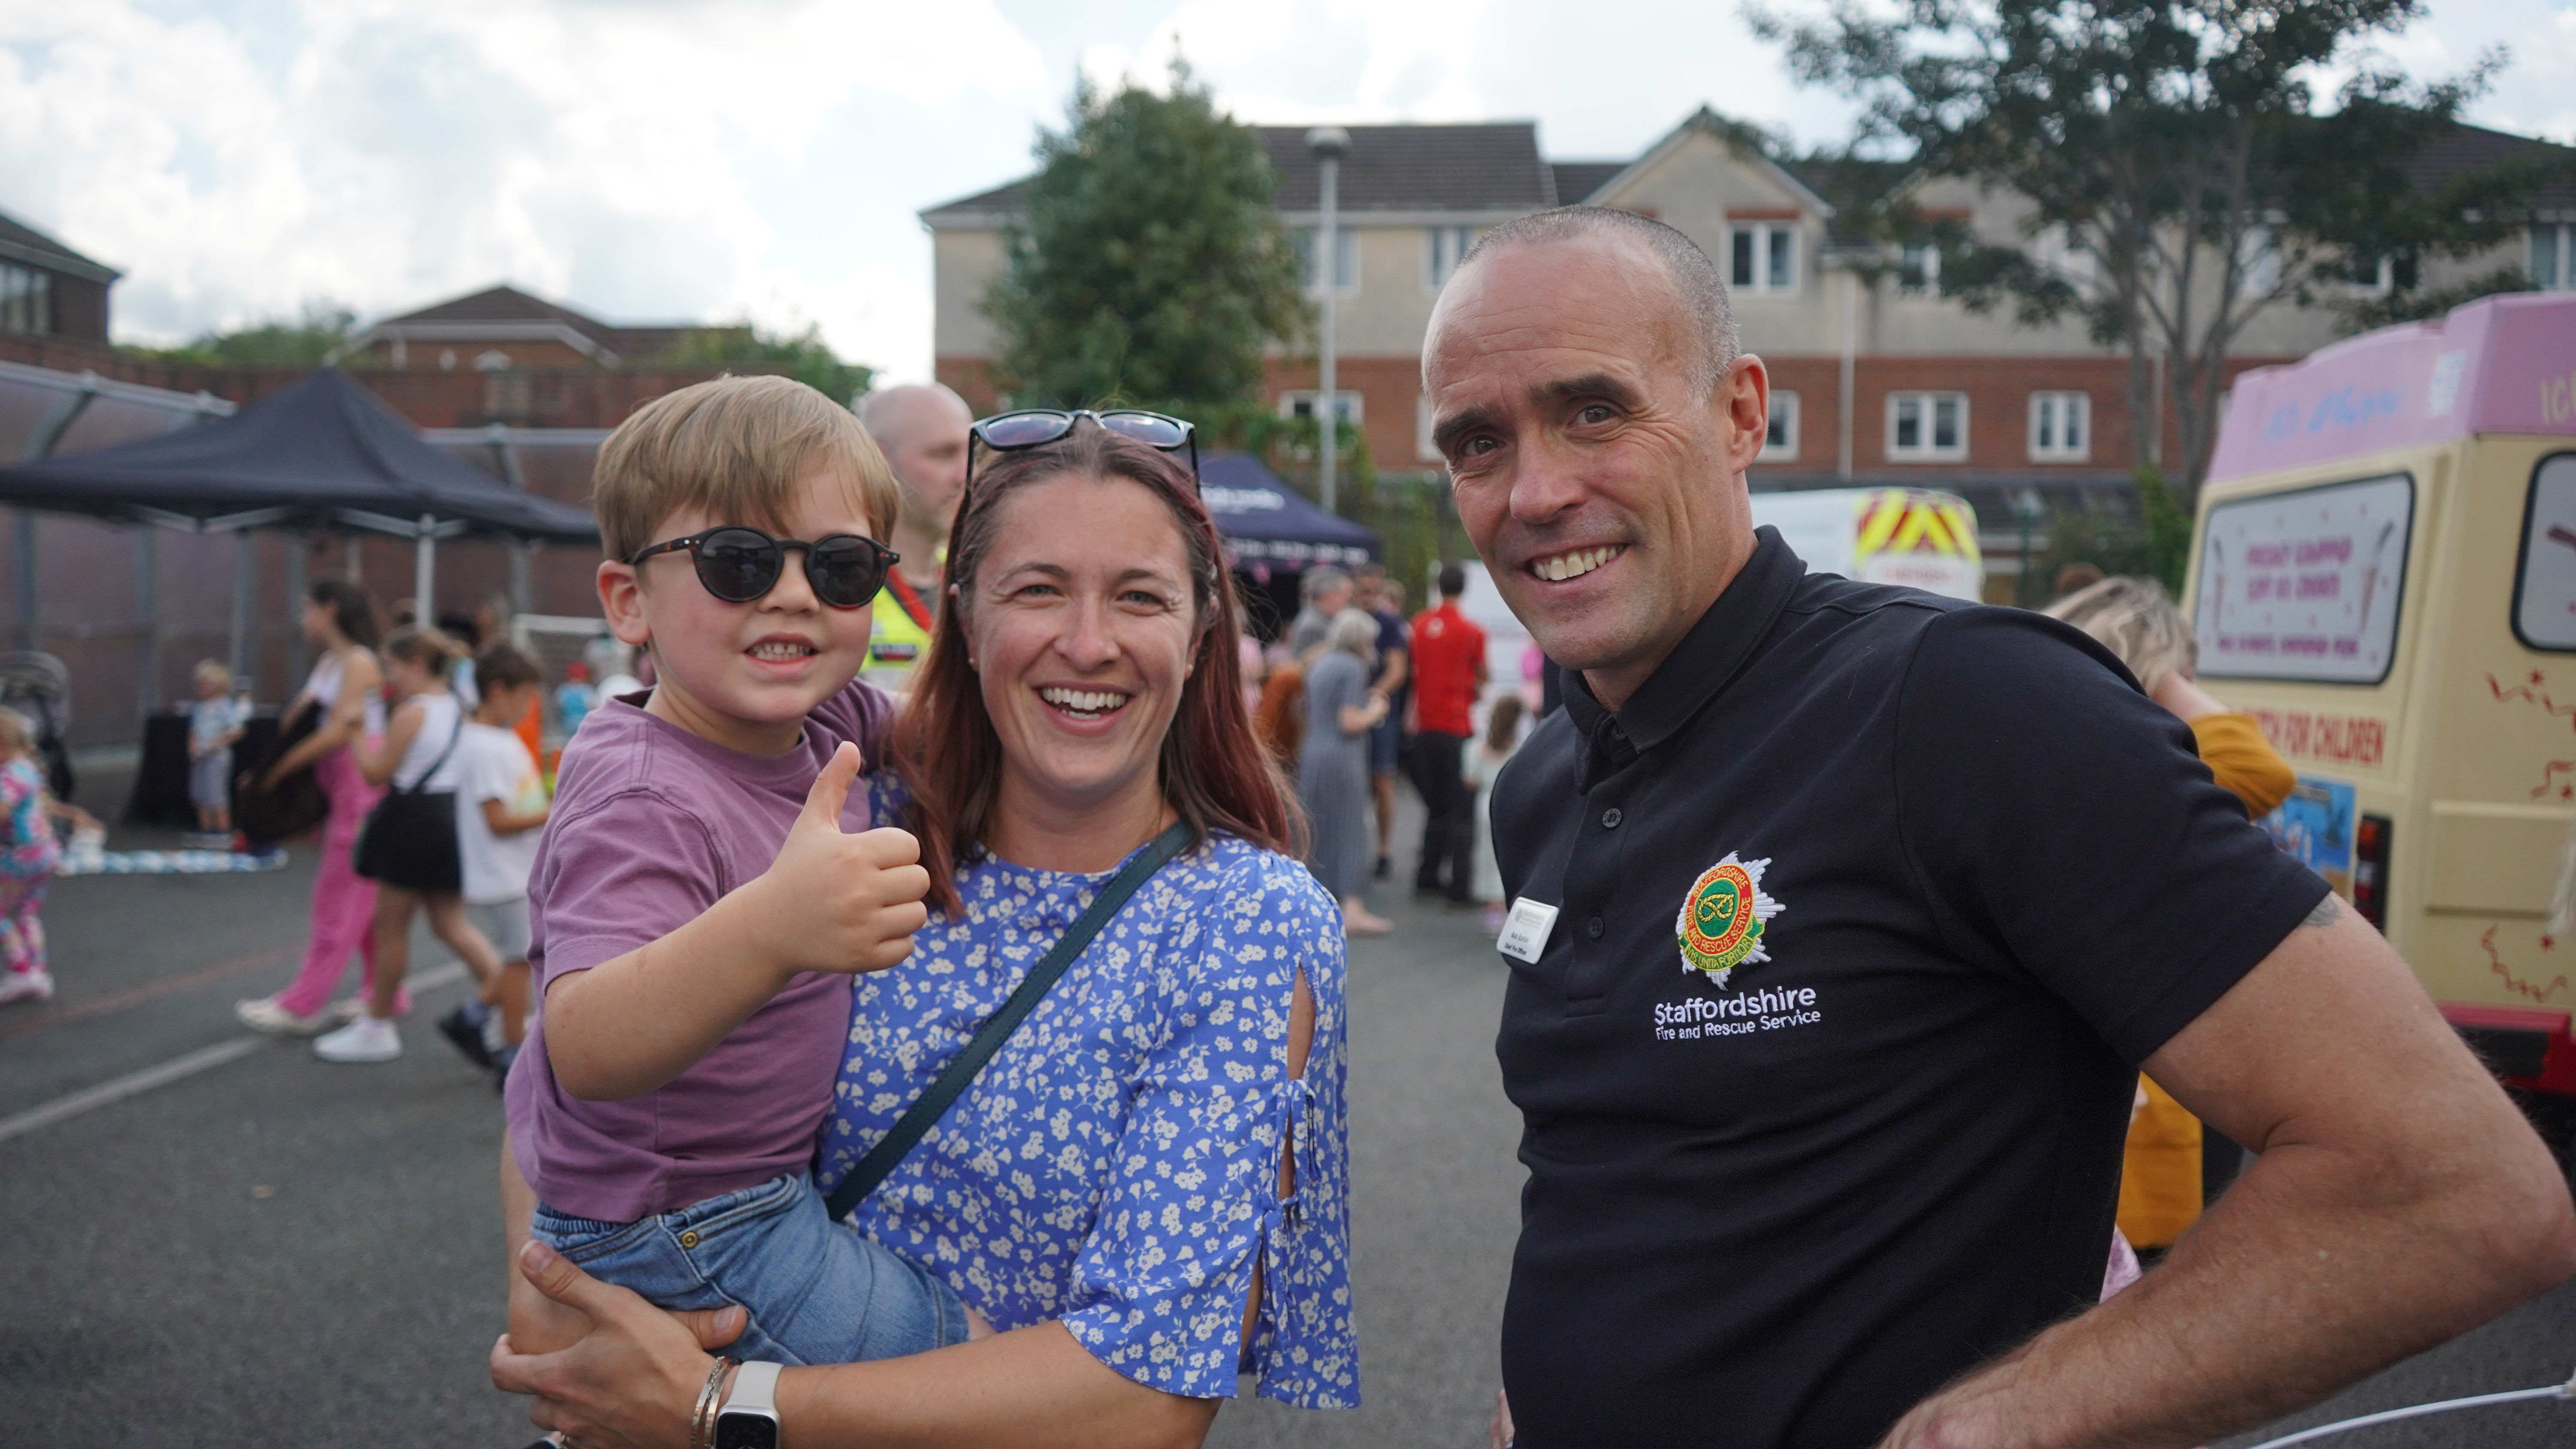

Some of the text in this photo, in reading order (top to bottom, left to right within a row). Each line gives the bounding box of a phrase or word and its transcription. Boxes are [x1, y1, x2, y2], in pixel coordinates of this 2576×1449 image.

[2285, 712, 2309, 756] FOR
[2313, 713, 2387, 766] CHILDREN
[1693, 867, 1749, 898] STAFFORDSHIRE
[1689, 928, 1701, 945] AND
[1700, 936, 1732, 952] RESCUE
[1731, 897, 1751, 940] SERVICE
[1686, 939, 1751, 969] VIS UNITA FORTIOR
[1655, 986, 1816, 1025] Staffordshire
[1656, 1009, 1821, 1040] Fire and Rescue Service
